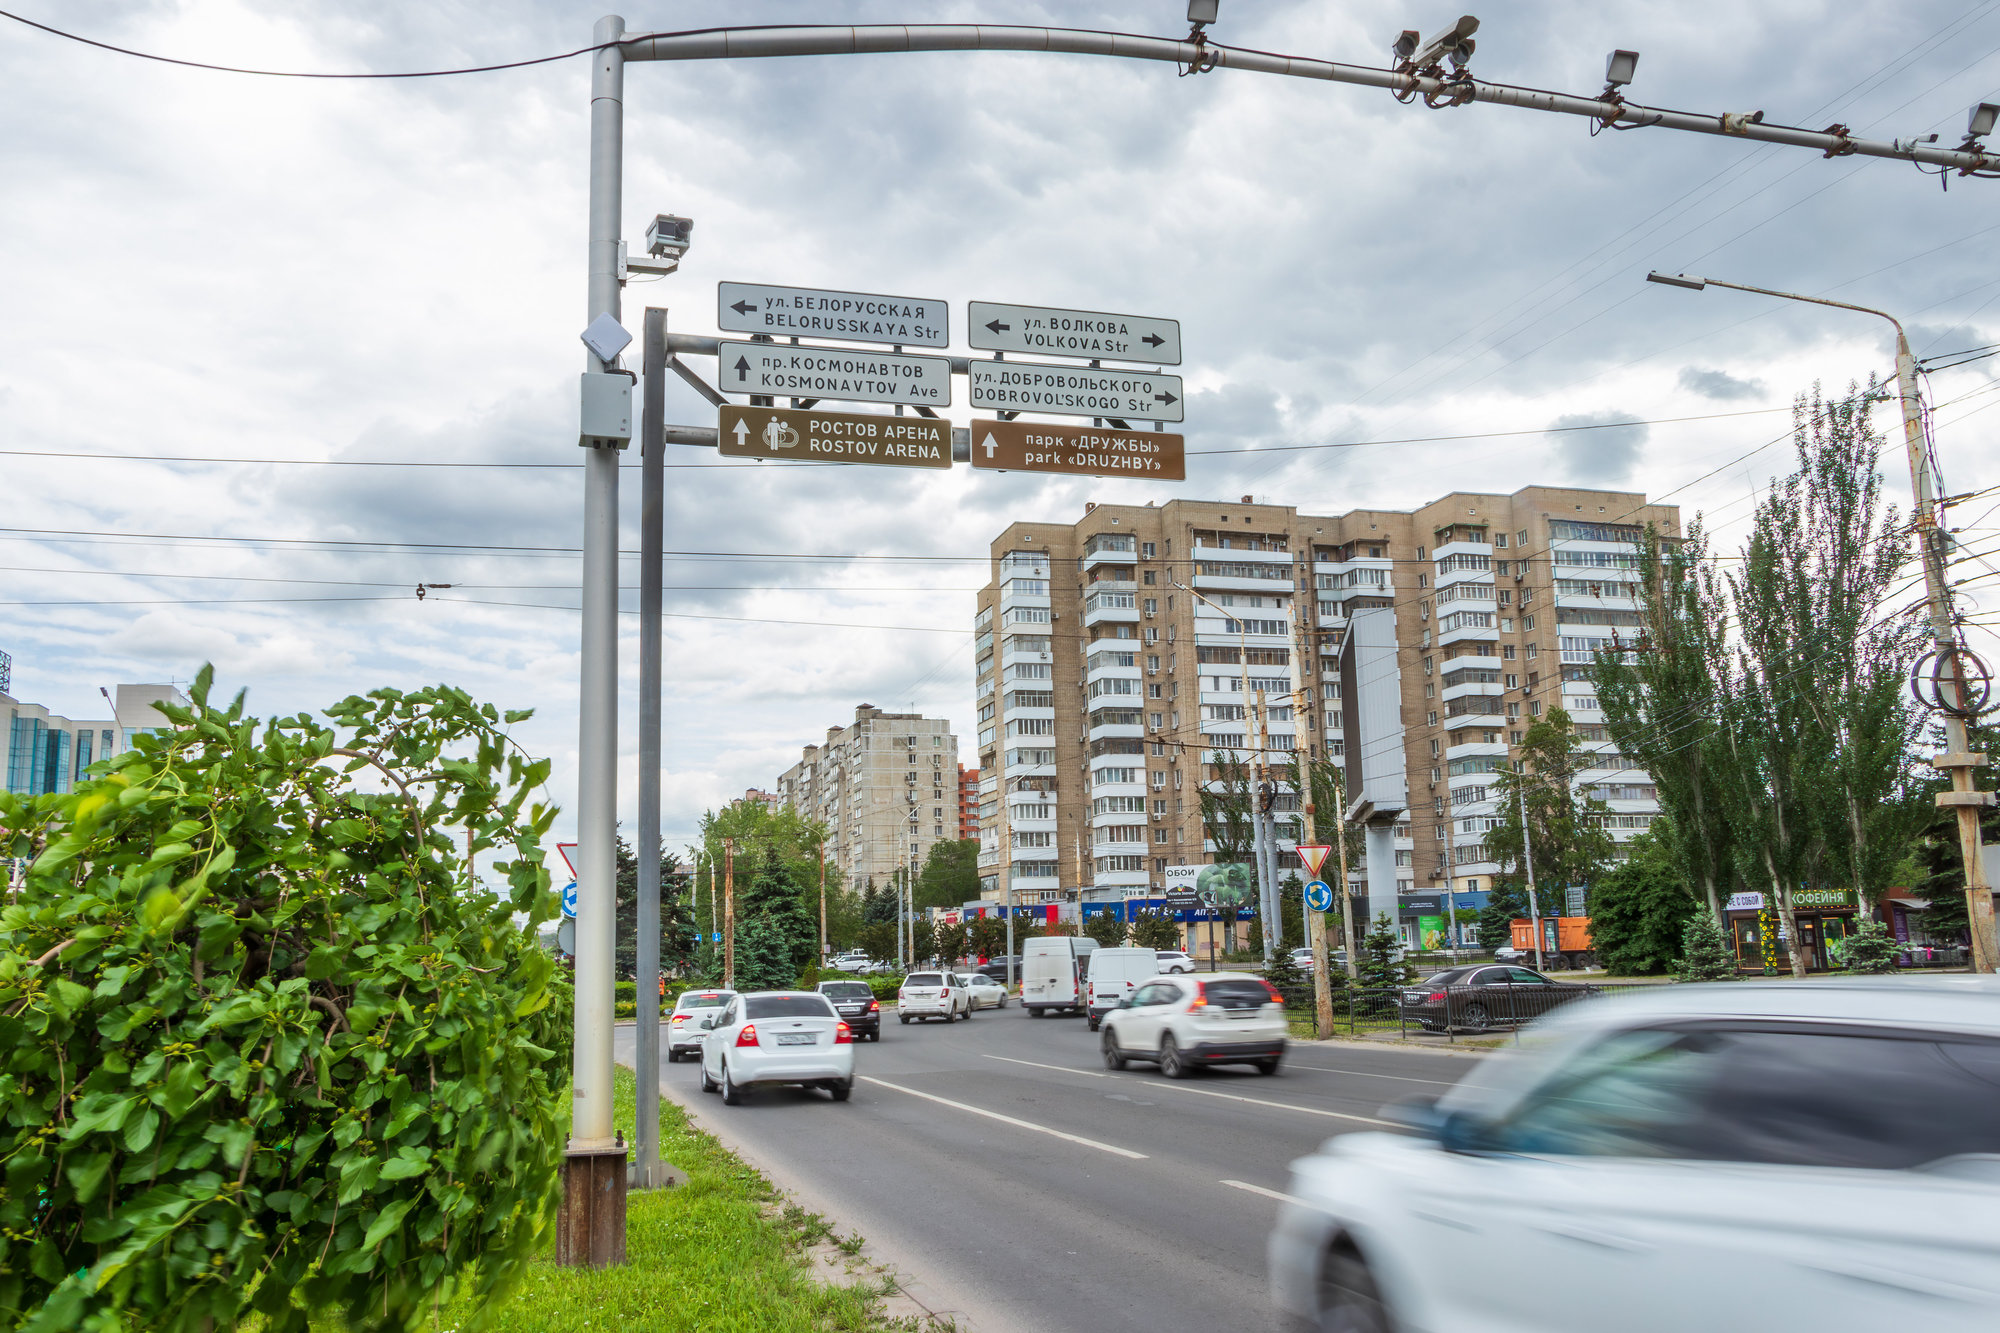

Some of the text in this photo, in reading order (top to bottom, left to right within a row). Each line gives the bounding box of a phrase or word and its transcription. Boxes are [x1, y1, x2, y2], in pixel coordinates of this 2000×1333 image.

[765, 313, 940, 339] BELORUSSKAYA Str
[1024, 333, 1129, 353] VOLKOVA Str
[762, 373, 938, 398] KOSMONAVTOV Ave
[1128, 399, 1153, 412] Str
[810, 420, 940, 441] РОСТОВ АРЕНА
[810, 438, 941, 459] ROSTOV ARENA
[1026, 434, 1160, 454] парк «ДРУЖБЫ»
[1025, 451, 1161, 471] park «DRUZHBY»
[1167, 869, 1195, 877] ОБОИ
